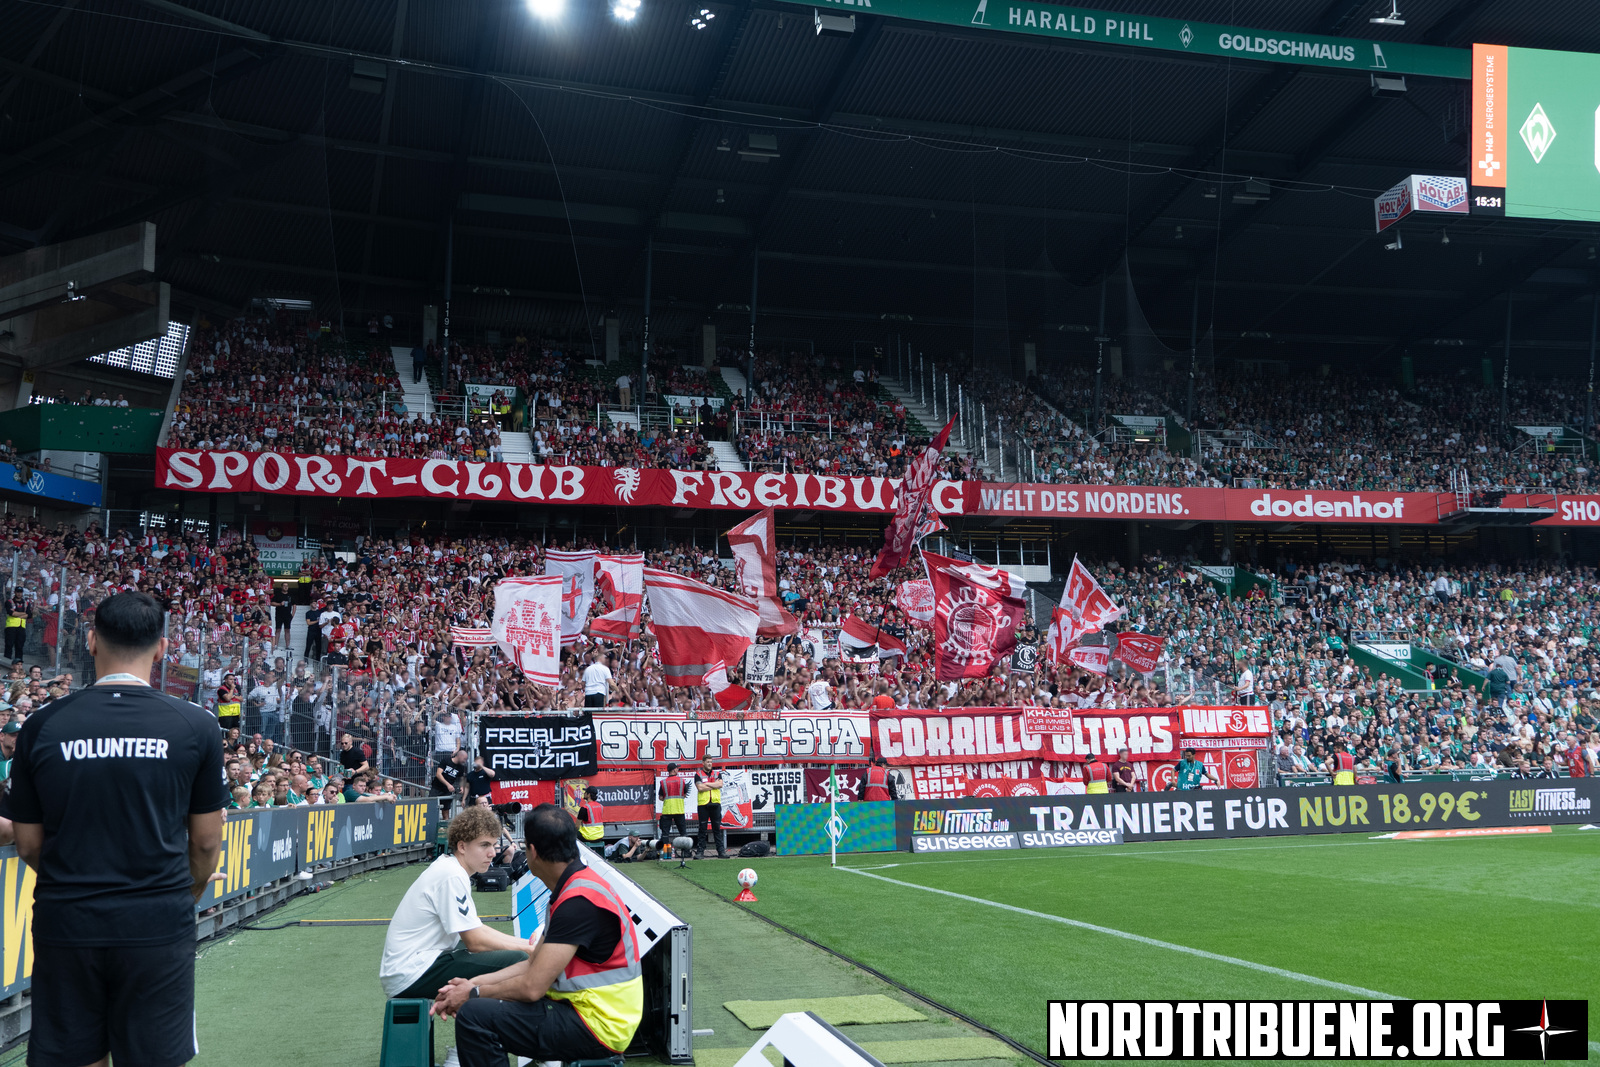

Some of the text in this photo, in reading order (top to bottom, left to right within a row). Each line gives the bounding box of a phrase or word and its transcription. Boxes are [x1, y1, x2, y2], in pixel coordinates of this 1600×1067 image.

[1009, 7, 1154, 41] HARALD PIHL
[1218, 33, 1355, 62] GOLDSCHMAUS
[1486, 55, 1494, 152] H&P ENERGIESYSTEME
[1475, 196, 1501, 208] 15:31
[165, 451, 964, 516] SPORT-CLUB FREIBUG
[980, 487, 1190, 516] WELT DES NORDENS.
[1250, 493, 1404, 519] dodenhof
[1221, 568, 1233, 576] 110
[1394, 648, 1409, 657] 110
[1027, 709, 1069, 718] KHALID
[60, 737, 169, 762] VOLUNTEER
[600, 718, 864, 761] SYNTHESIA
[1206, 739, 1225, 747] STATT
[1229, 738, 1265, 747] INVESTOREN
[752, 771, 801, 786] SCHEISS
[916, 778, 966, 792] BALL
[511, 790, 529, 800] 2022
[774, 785, 801, 805] DFL
[393, 804, 428, 845] EWE
[1029, 799, 1215, 834] TRAINIERE
[1224, 796, 1289, 831] FÜR
[1298, 795, 1370, 827] NUR
[306, 810, 335, 864] EWE
[354, 818, 373, 842] ewe.de
[1023, 827, 1118, 846] sunseeker
[272, 830, 292, 863] ewe.de
[917, 835, 1014, 851] sunseeker
[214, 818, 253, 899] EWE
